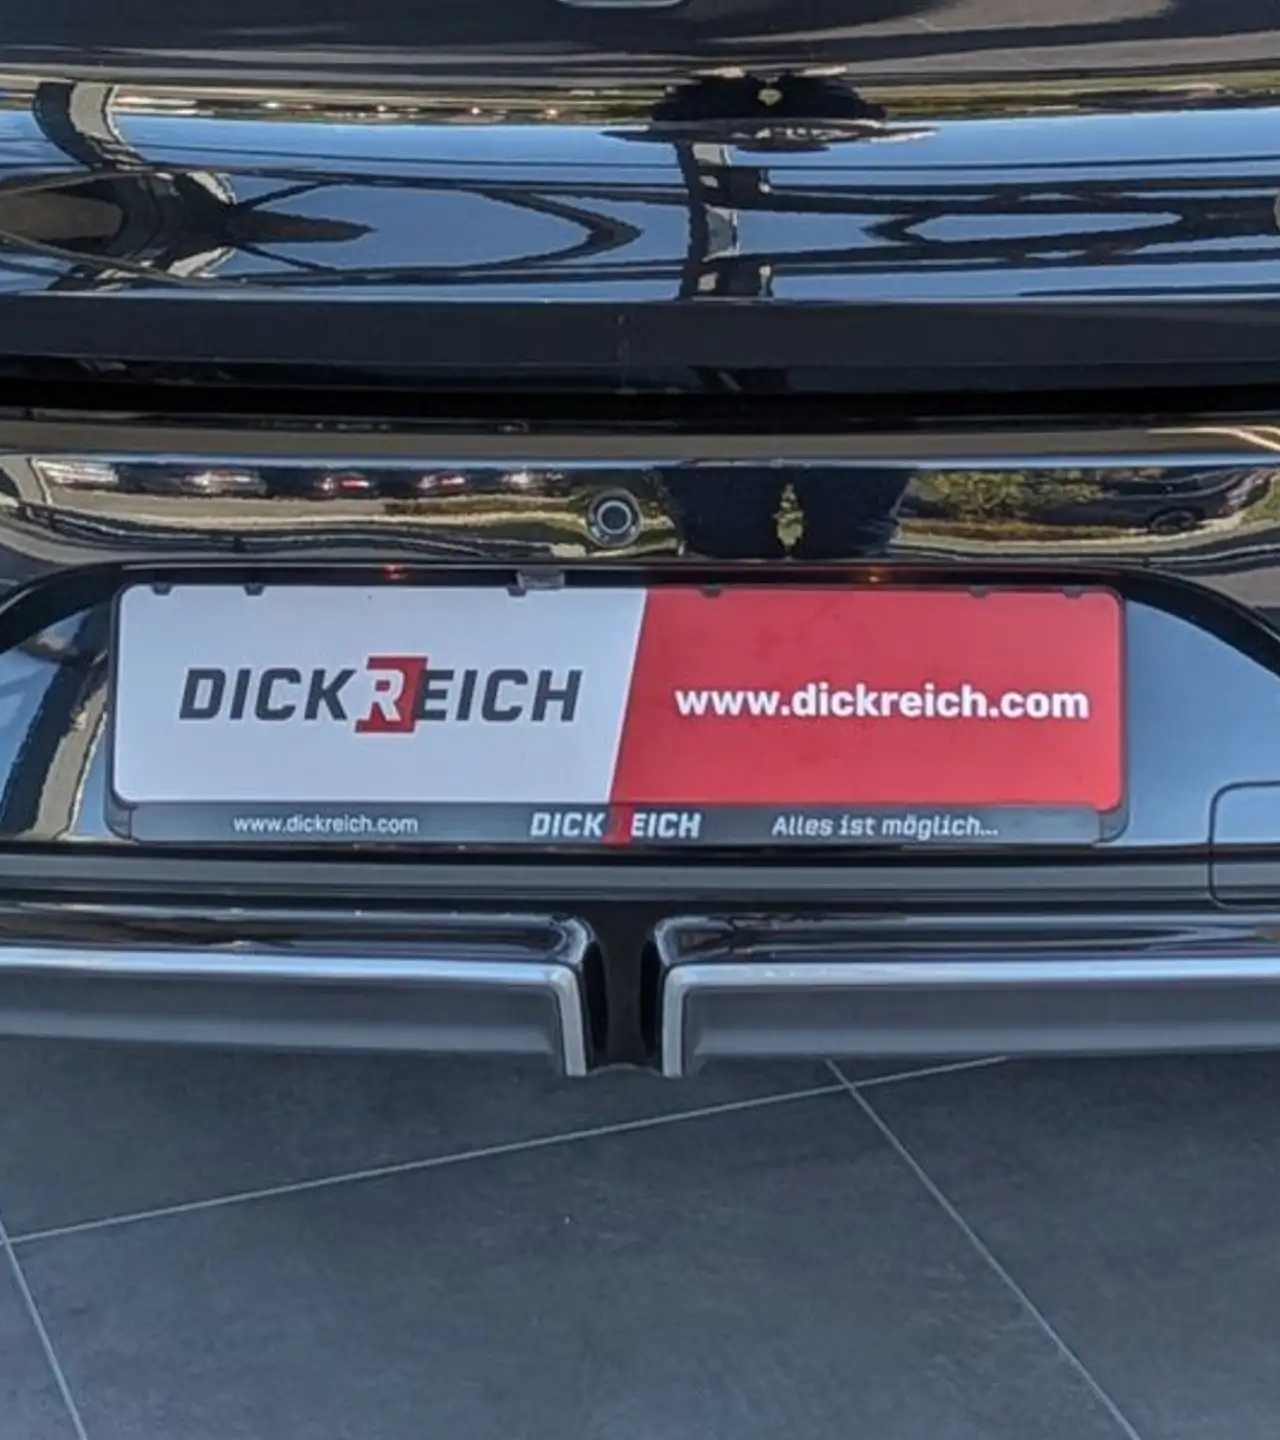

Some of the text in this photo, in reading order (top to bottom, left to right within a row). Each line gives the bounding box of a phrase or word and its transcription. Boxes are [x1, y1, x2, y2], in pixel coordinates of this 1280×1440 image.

[178, 658, 583, 731] DICKREICH
[673, 682, 1090, 719] www.dickreich.com
[232, 814, 419, 834] www.dickreich.com
[771, 813, 999, 841] Alles ist möglich...
